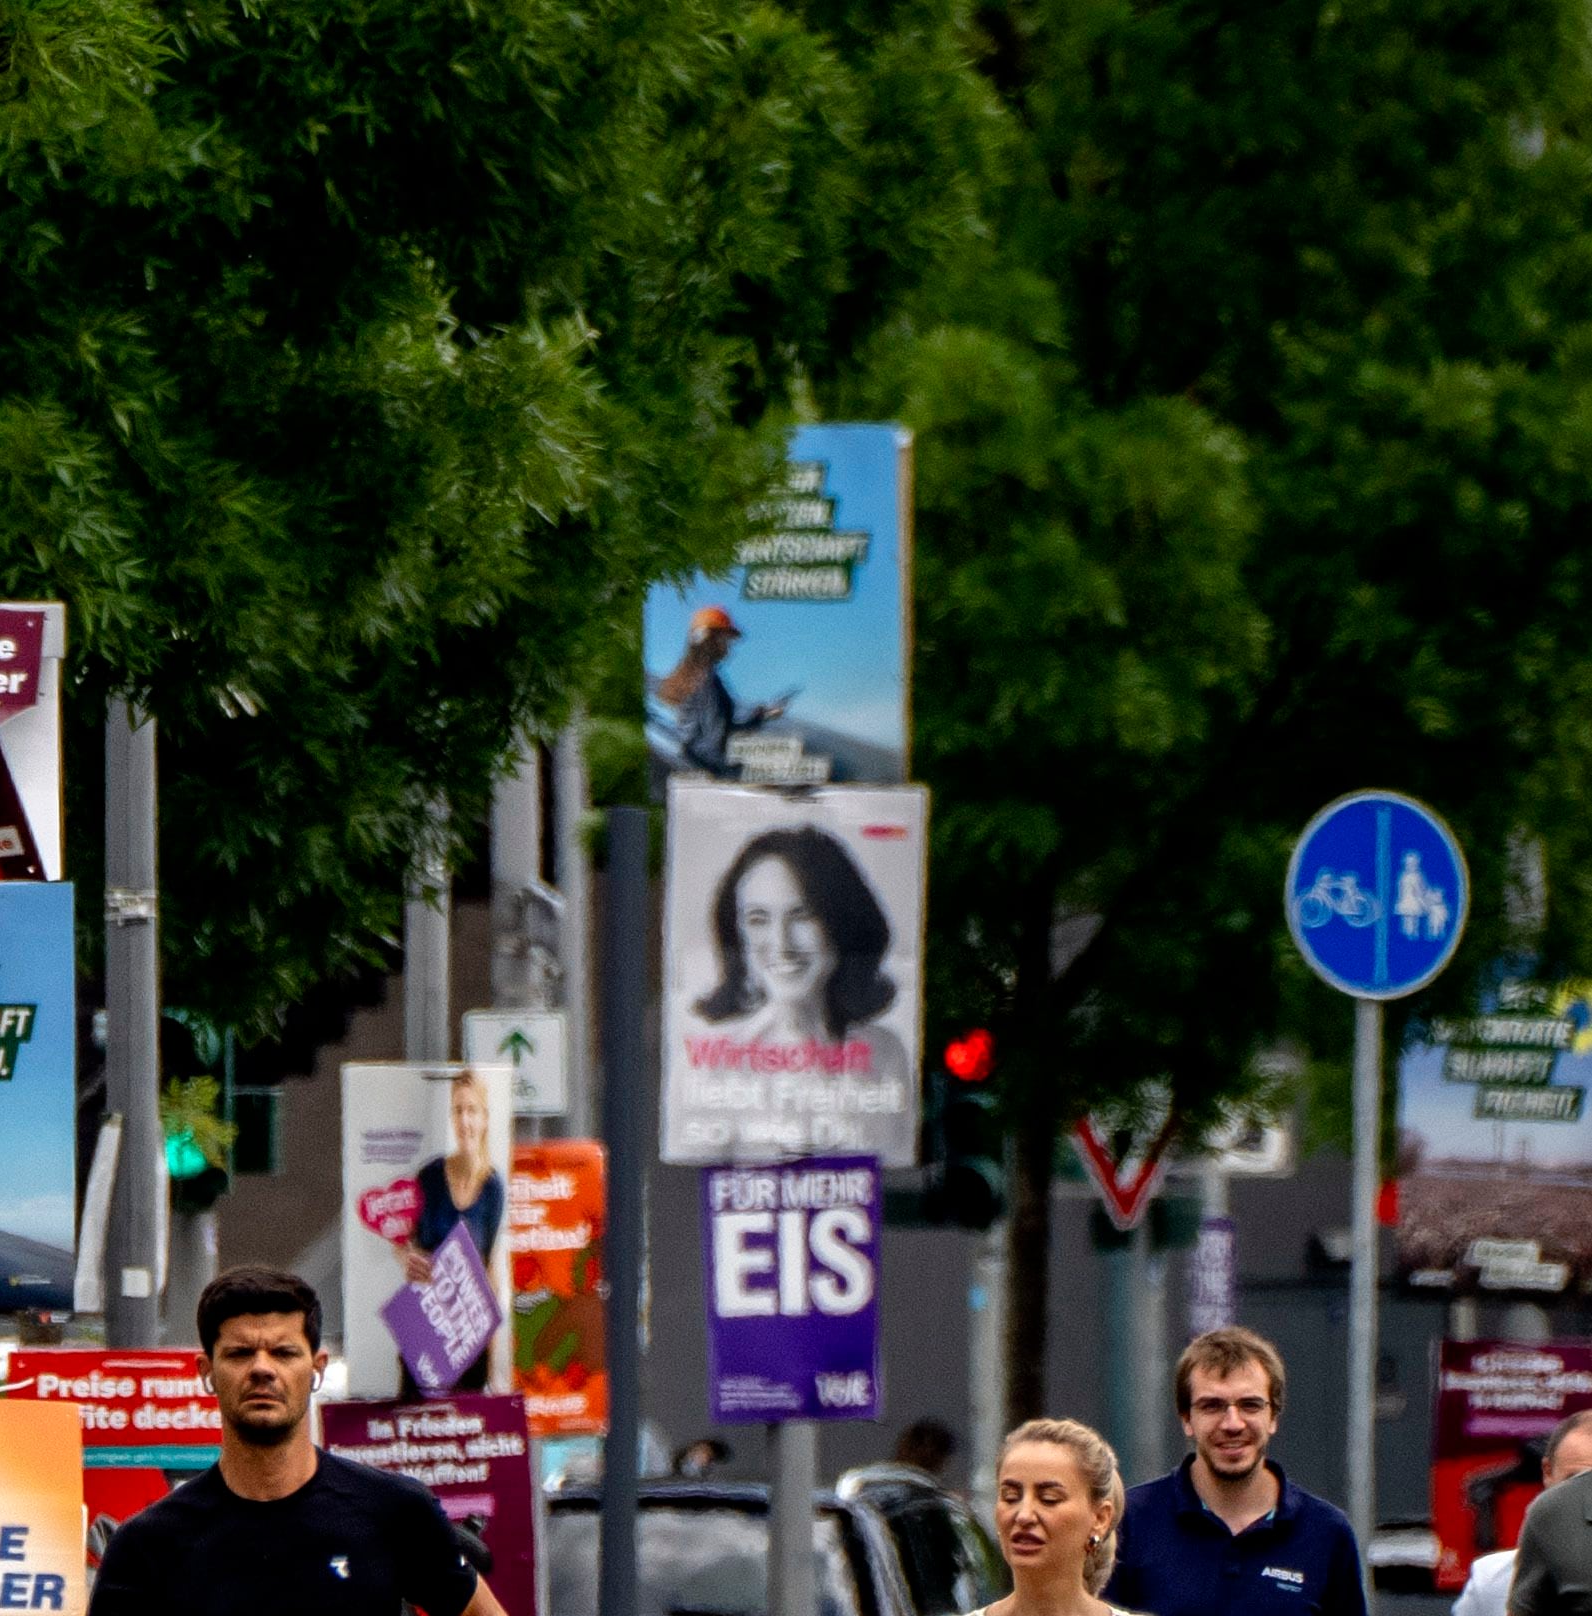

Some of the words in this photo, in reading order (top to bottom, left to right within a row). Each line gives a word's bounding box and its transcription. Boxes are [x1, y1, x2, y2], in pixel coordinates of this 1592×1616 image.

[710, 1169, 778, 1211] FÜR
[780, 1169, 873, 1209] MEHR
[713, 1208, 874, 1318] EIS
[37, 1370, 136, 1398] Preise
[141, 1374, 203, 1398] runt
[79, 1404, 129, 1430] fite
[133, 1401, 223, 1430] decke
[1261, 1566, 1304, 1584] AIRBUS
